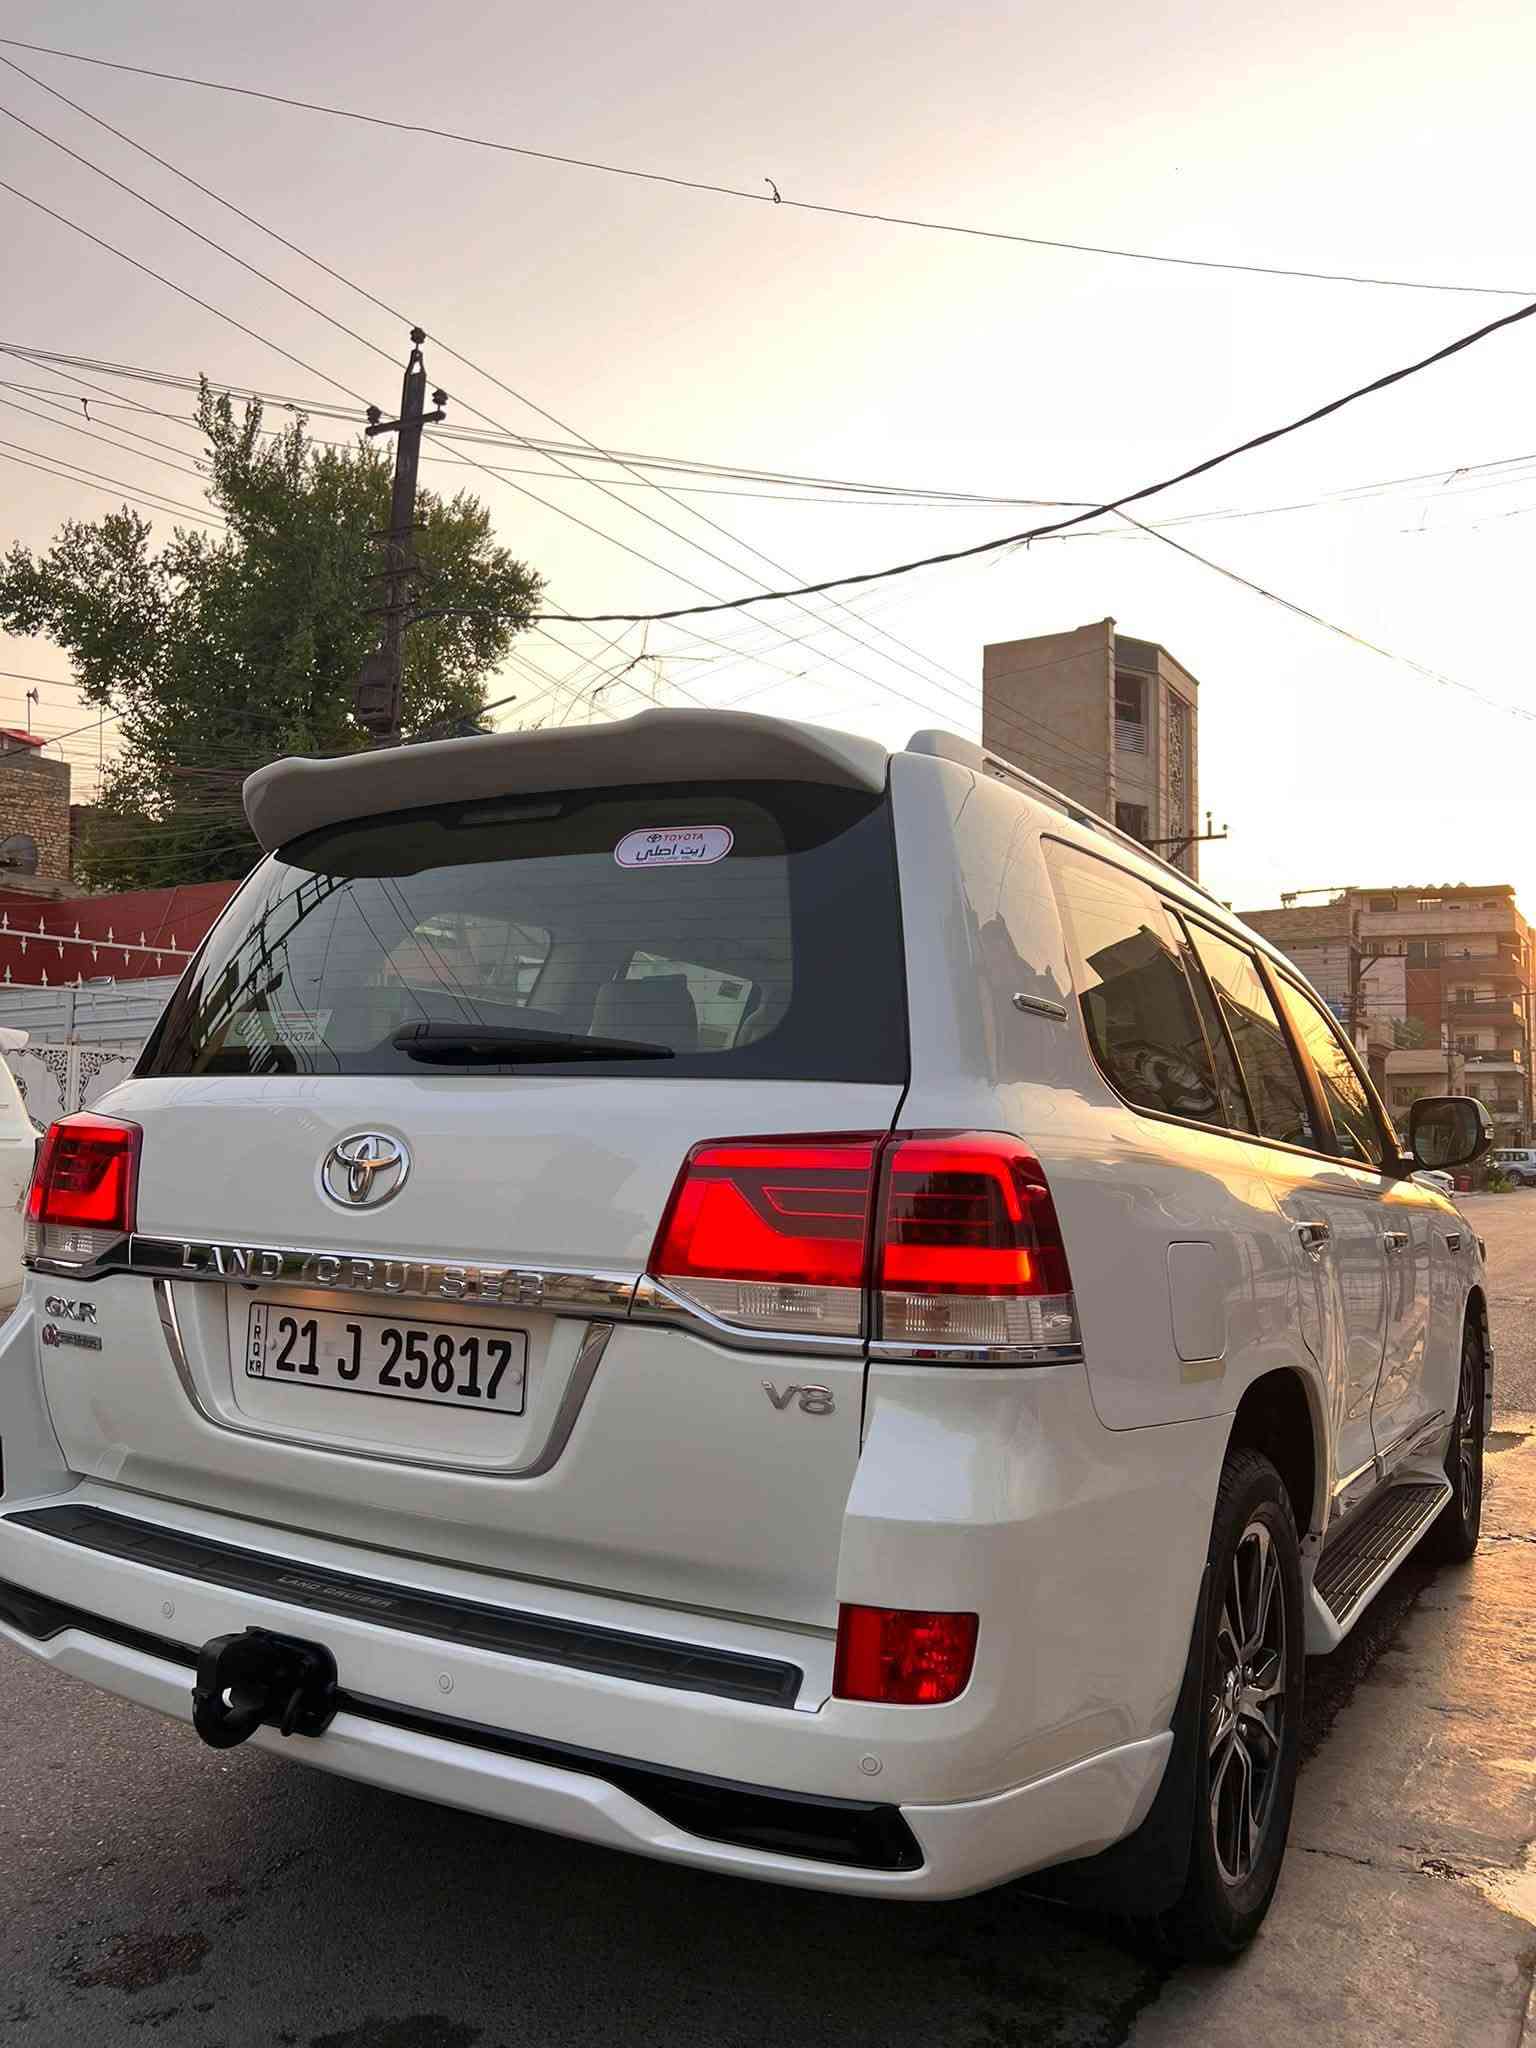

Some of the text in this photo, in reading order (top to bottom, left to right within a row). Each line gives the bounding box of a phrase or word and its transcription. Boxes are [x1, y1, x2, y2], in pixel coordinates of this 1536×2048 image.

[664, 833, 704, 841] TOYOTA
[274, 1031, 316, 1041] TOYOTA
[182, 1243, 544, 1305] LAND CRUISER
[276, 1316, 512, 1400] 21 J 25817
[761, 1380, 835, 1415] V8
